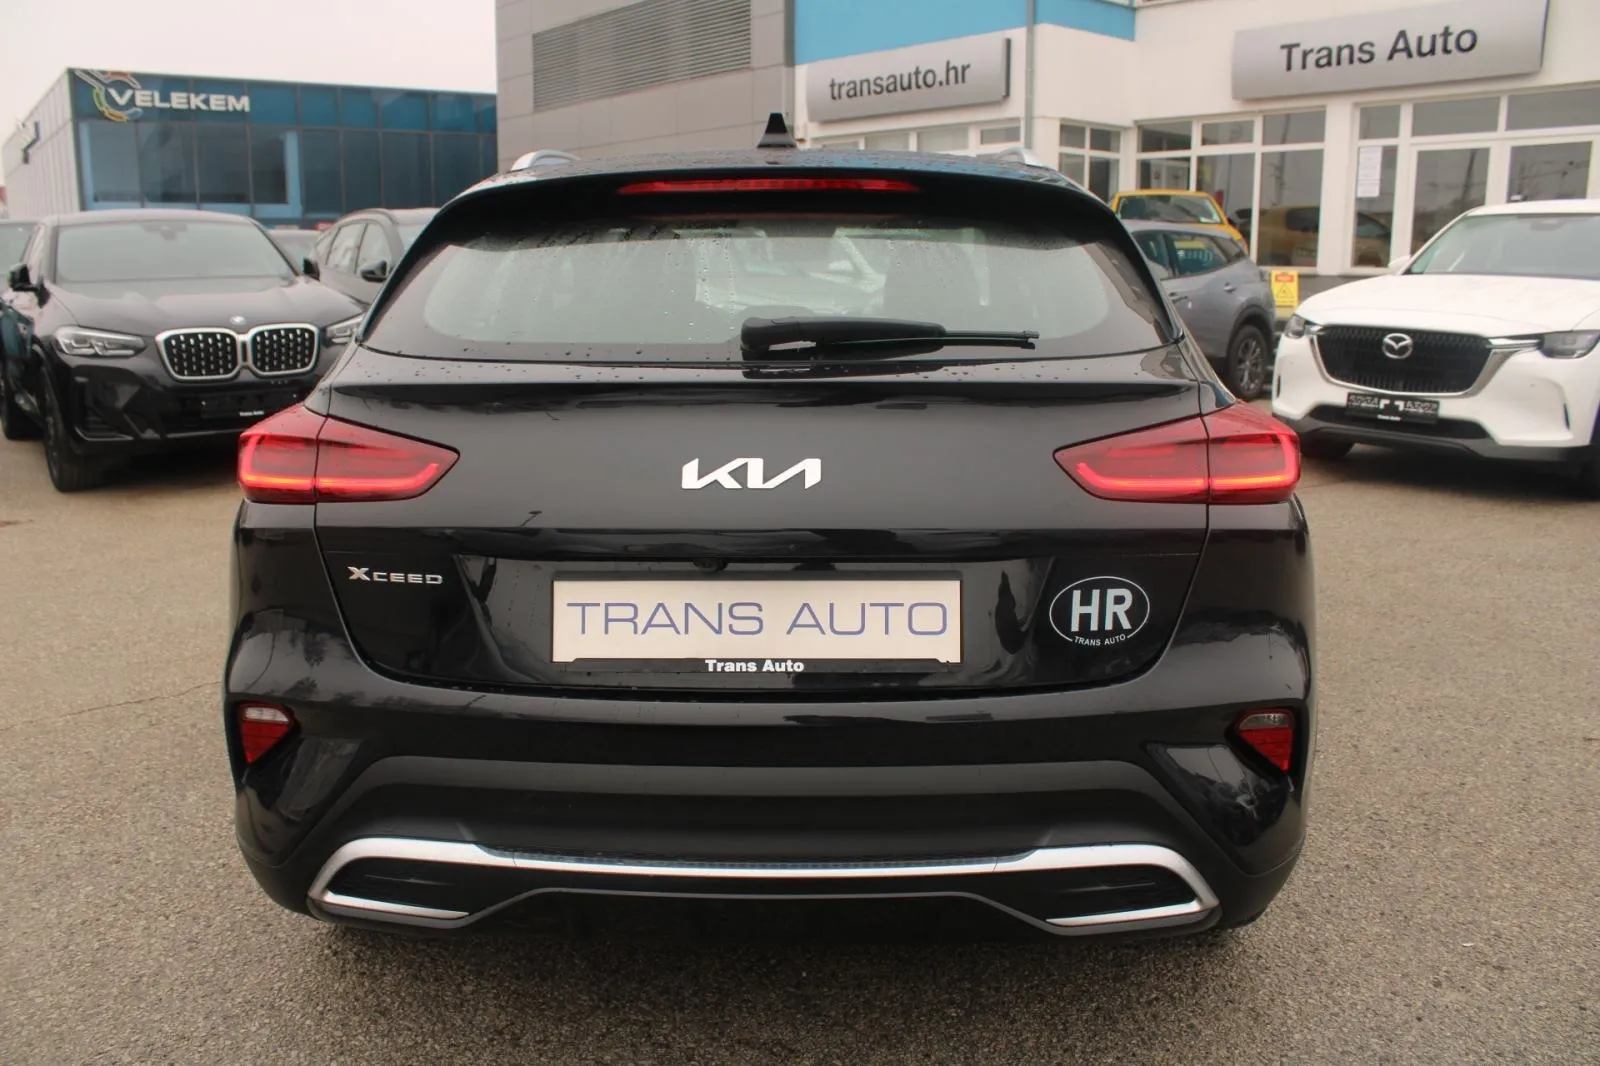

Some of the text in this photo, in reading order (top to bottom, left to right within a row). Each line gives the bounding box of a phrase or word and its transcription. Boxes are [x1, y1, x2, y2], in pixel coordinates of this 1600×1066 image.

[1280, 25, 1478, 72] Trans Auto
[829, 60, 971, 101] transauto.hr
[107, 87, 250, 112] VELEKEM
[681, 457, 822, 490] KIA
[566, 602, 948, 636] TRANS AUTO
[1070, 588, 1133, 632] HR
[1074, 633, 1127, 646] TRANS AUTO
[704, 659, 805, 672] Trans Auto
